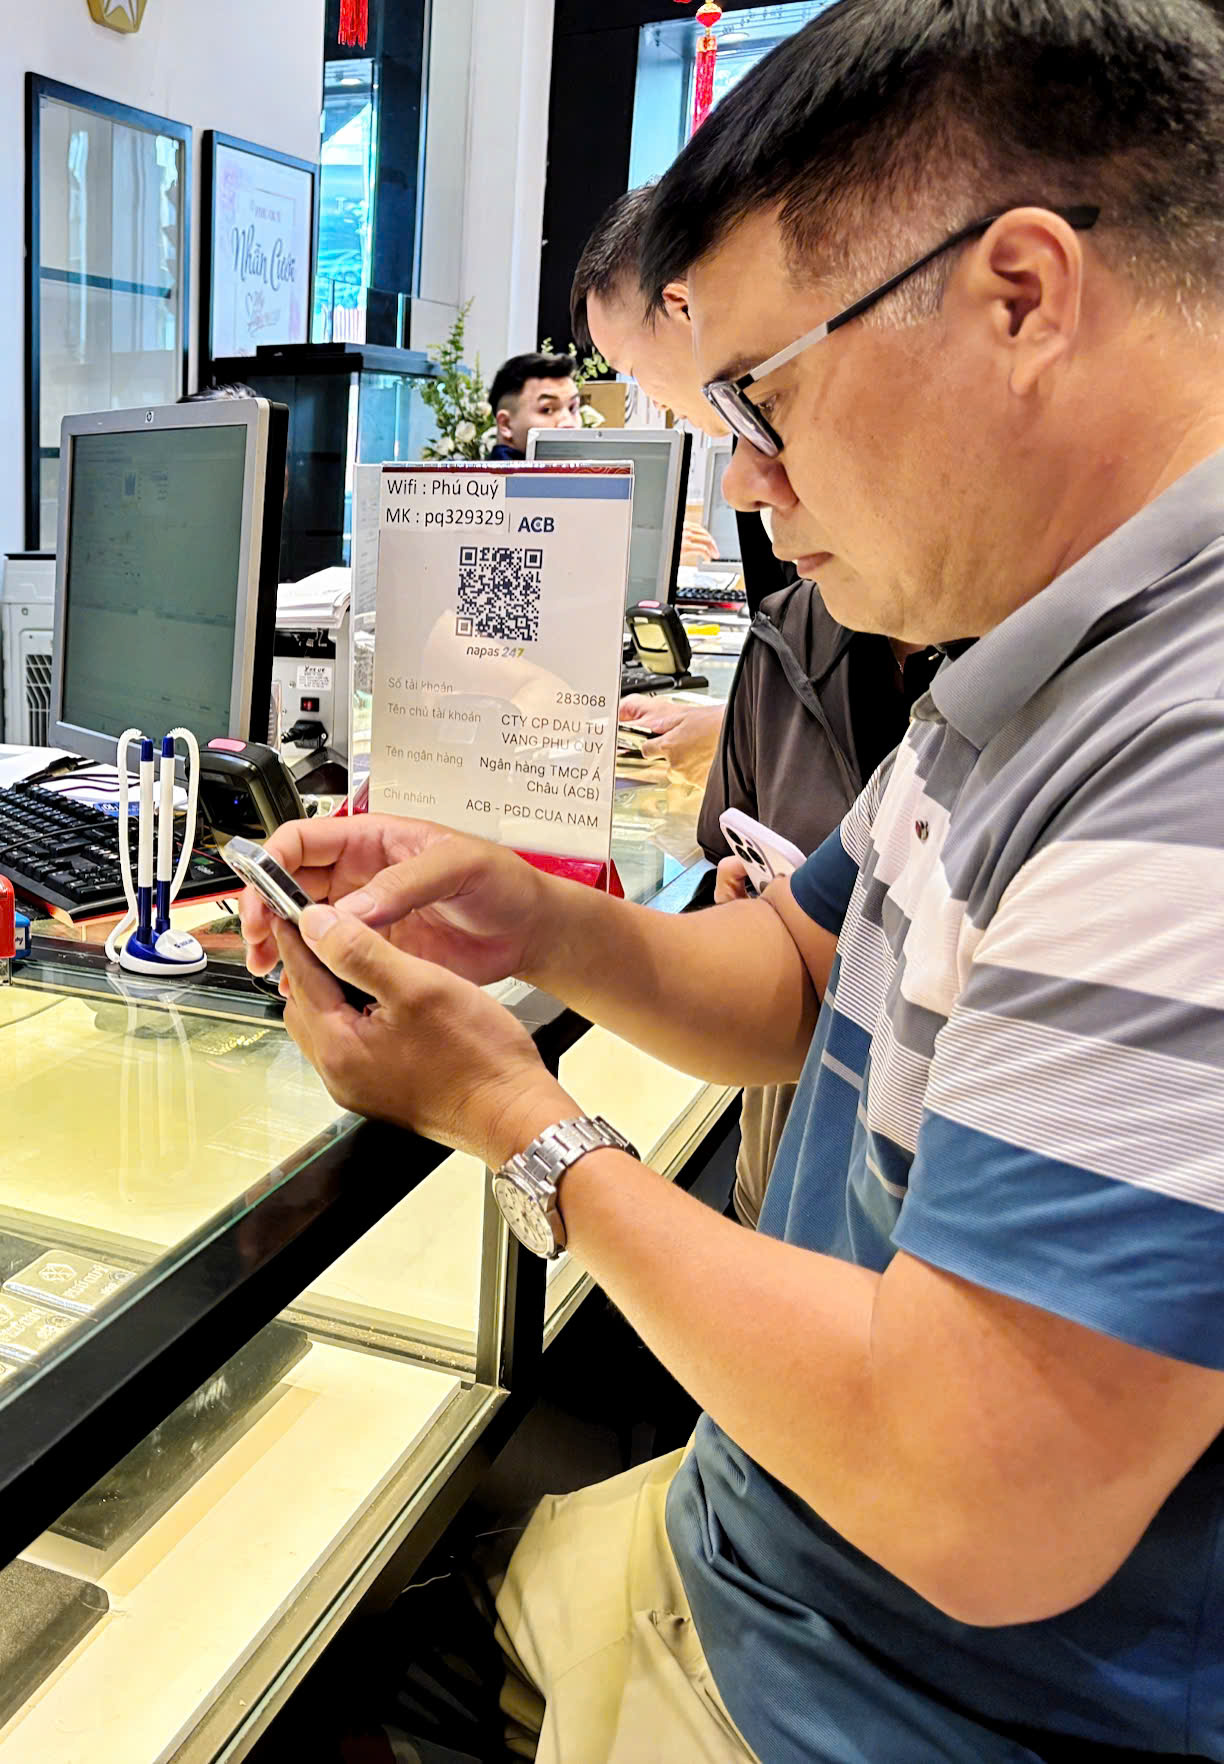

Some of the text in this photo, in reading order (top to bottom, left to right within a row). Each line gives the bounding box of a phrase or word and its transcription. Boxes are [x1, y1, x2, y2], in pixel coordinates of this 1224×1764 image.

[387, 478, 417, 495] Wifi
[432, 479, 461, 496] Phú
[466, 479, 498, 500] Quý
[386, 508, 411, 523] MK
[425, 509, 504, 528] pq329329
[517, 516, 555, 533] ACB
[466, 646, 525, 659] napas 247
[388, 702, 406, 715] Tên
[556, 692, 606, 708] 283068
[501, 713, 604, 735] CTY CP DAU TU
[502, 732, 538, 746] VANG
[542, 736, 569, 750] PHU
[385, 744, 404, 758] Tên
[407, 749, 433, 762] ngân
[480, 756, 601, 782] Ngân hàng TMCP Á
[527, 779, 600, 801] Châu (ACB)
[466, 799, 491, 813] ACB
[504, 803, 531, 819] PGD
[535, 808, 563, 823] CUA
[567, 812, 598, 828] NAM
